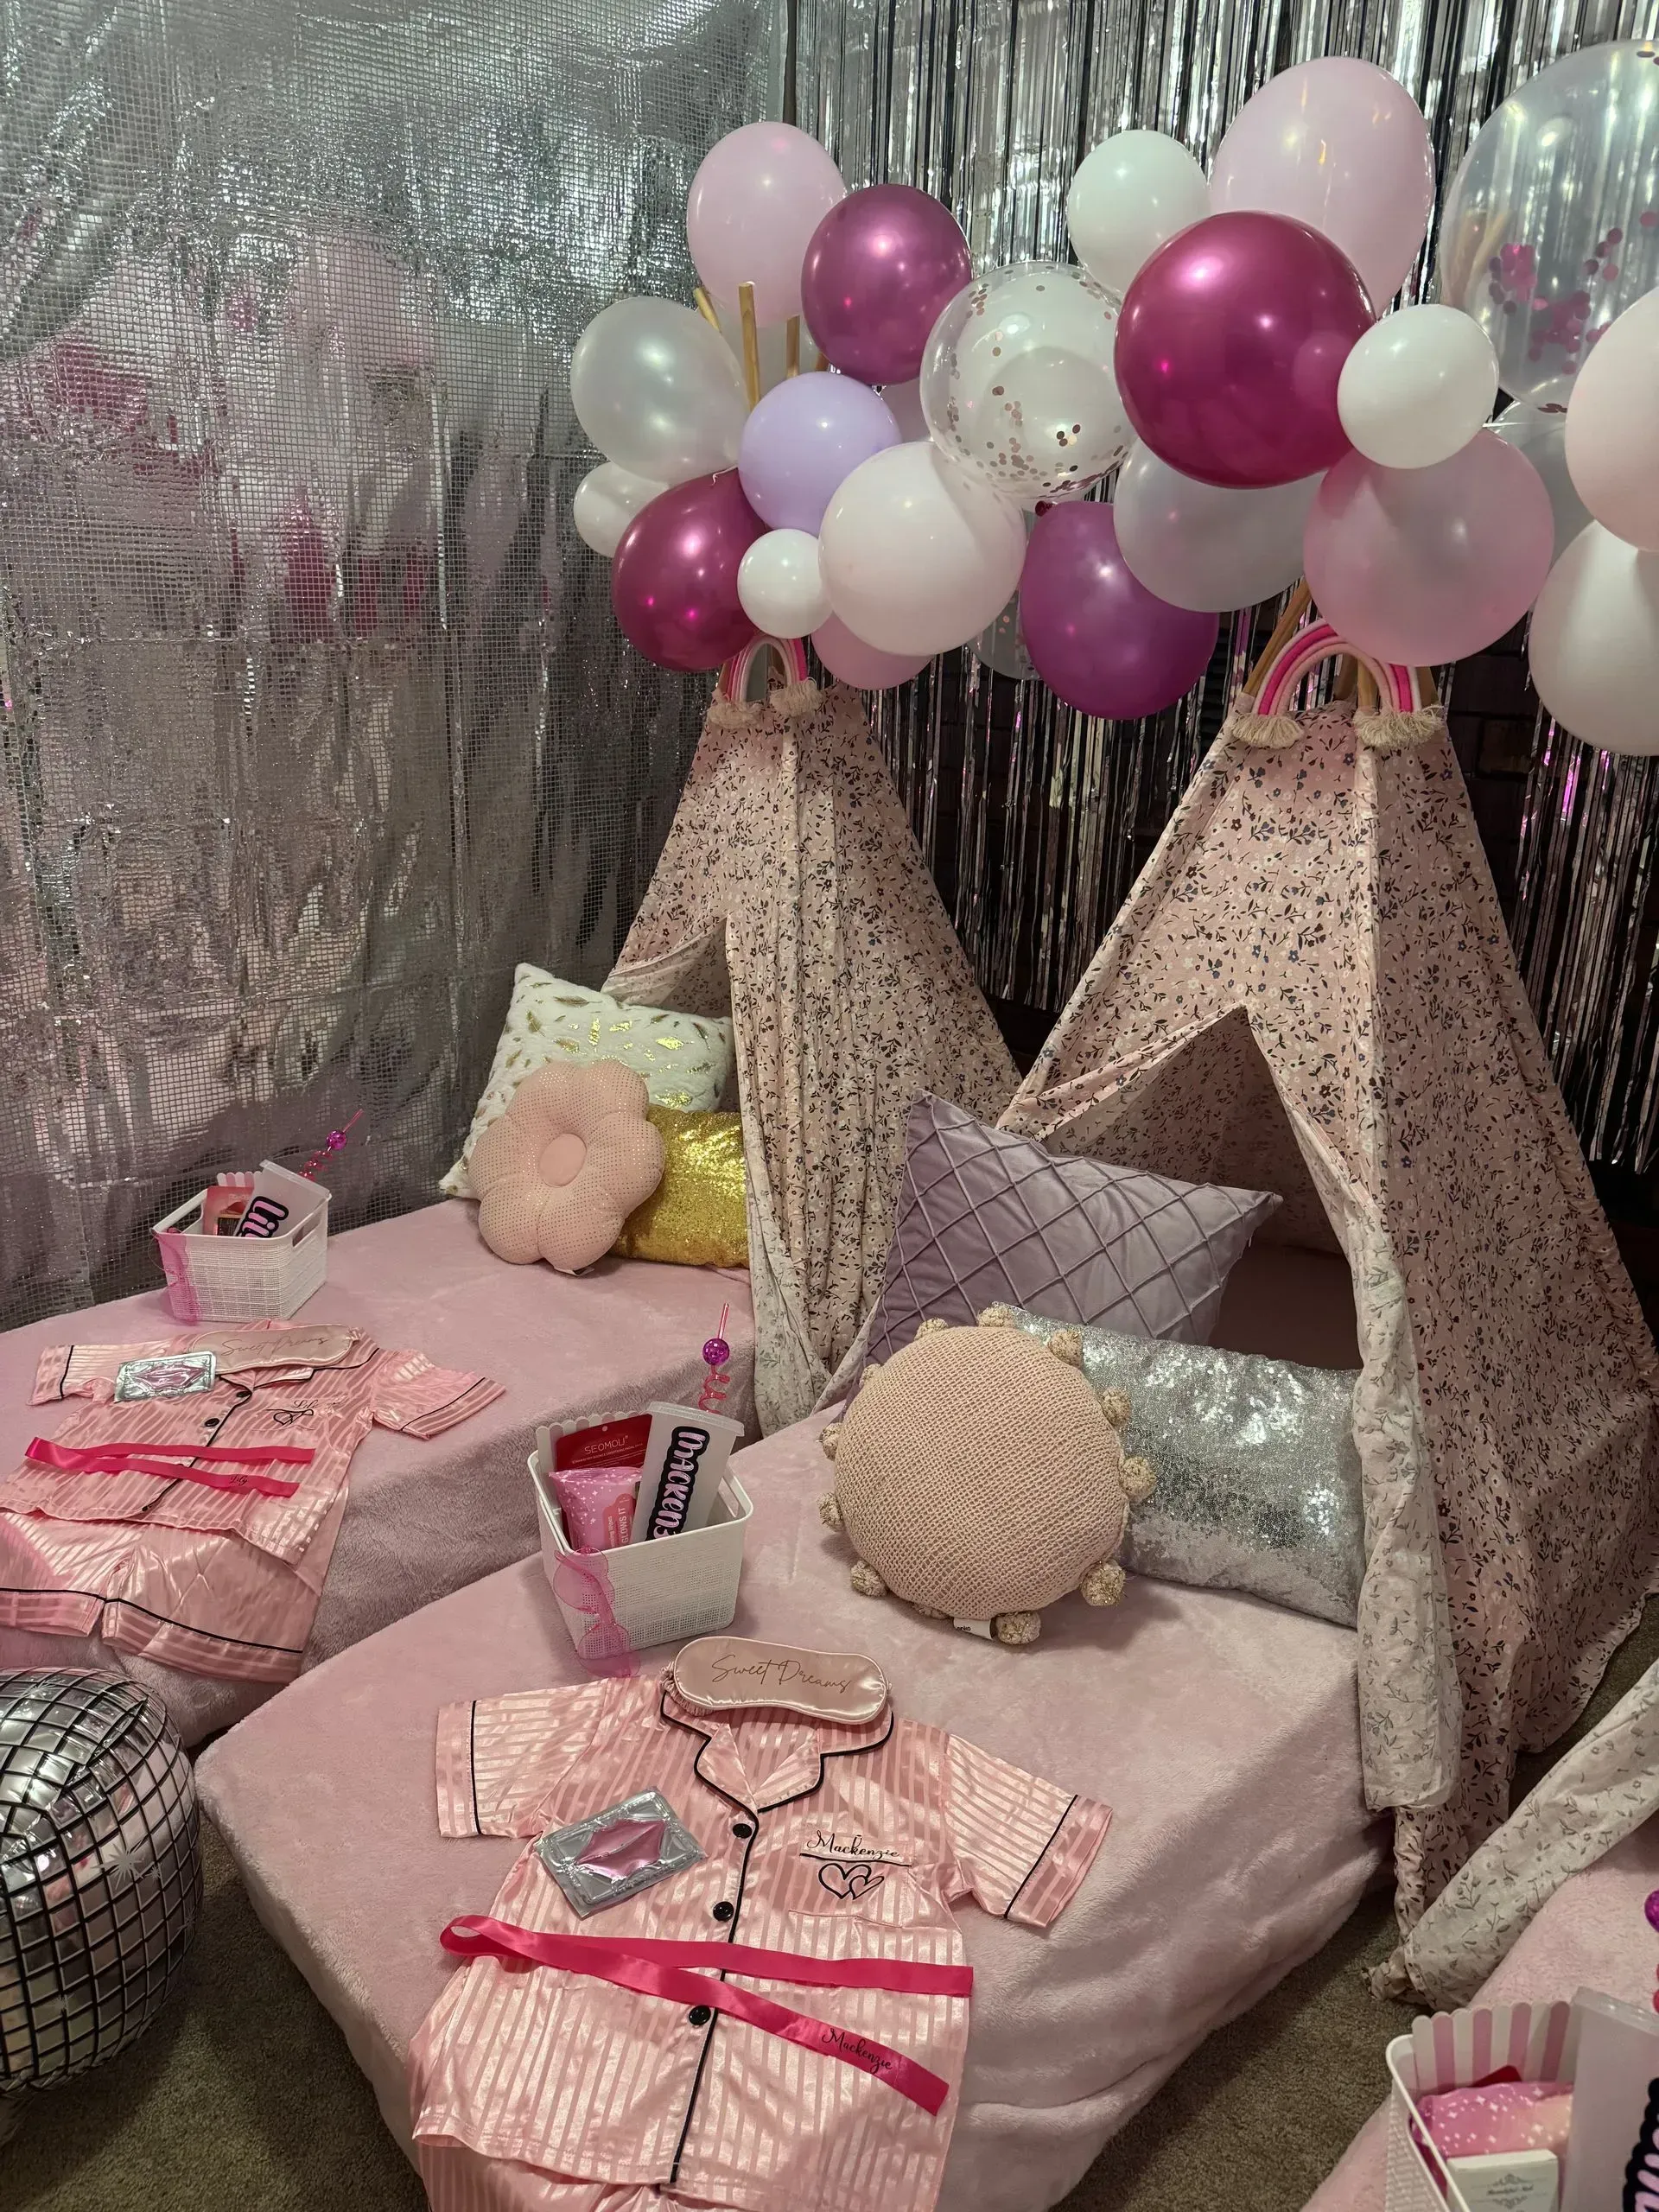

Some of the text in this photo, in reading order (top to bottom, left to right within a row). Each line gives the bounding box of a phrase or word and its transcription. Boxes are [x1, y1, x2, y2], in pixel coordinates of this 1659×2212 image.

[620, 1516, 629, 1543] GLOWS
[712, 1654, 852, 1694] Sweet Dreams
[806, 1829, 900, 1860] Mackenzie
[822, 2027, 893, 2075] Mackenzie
